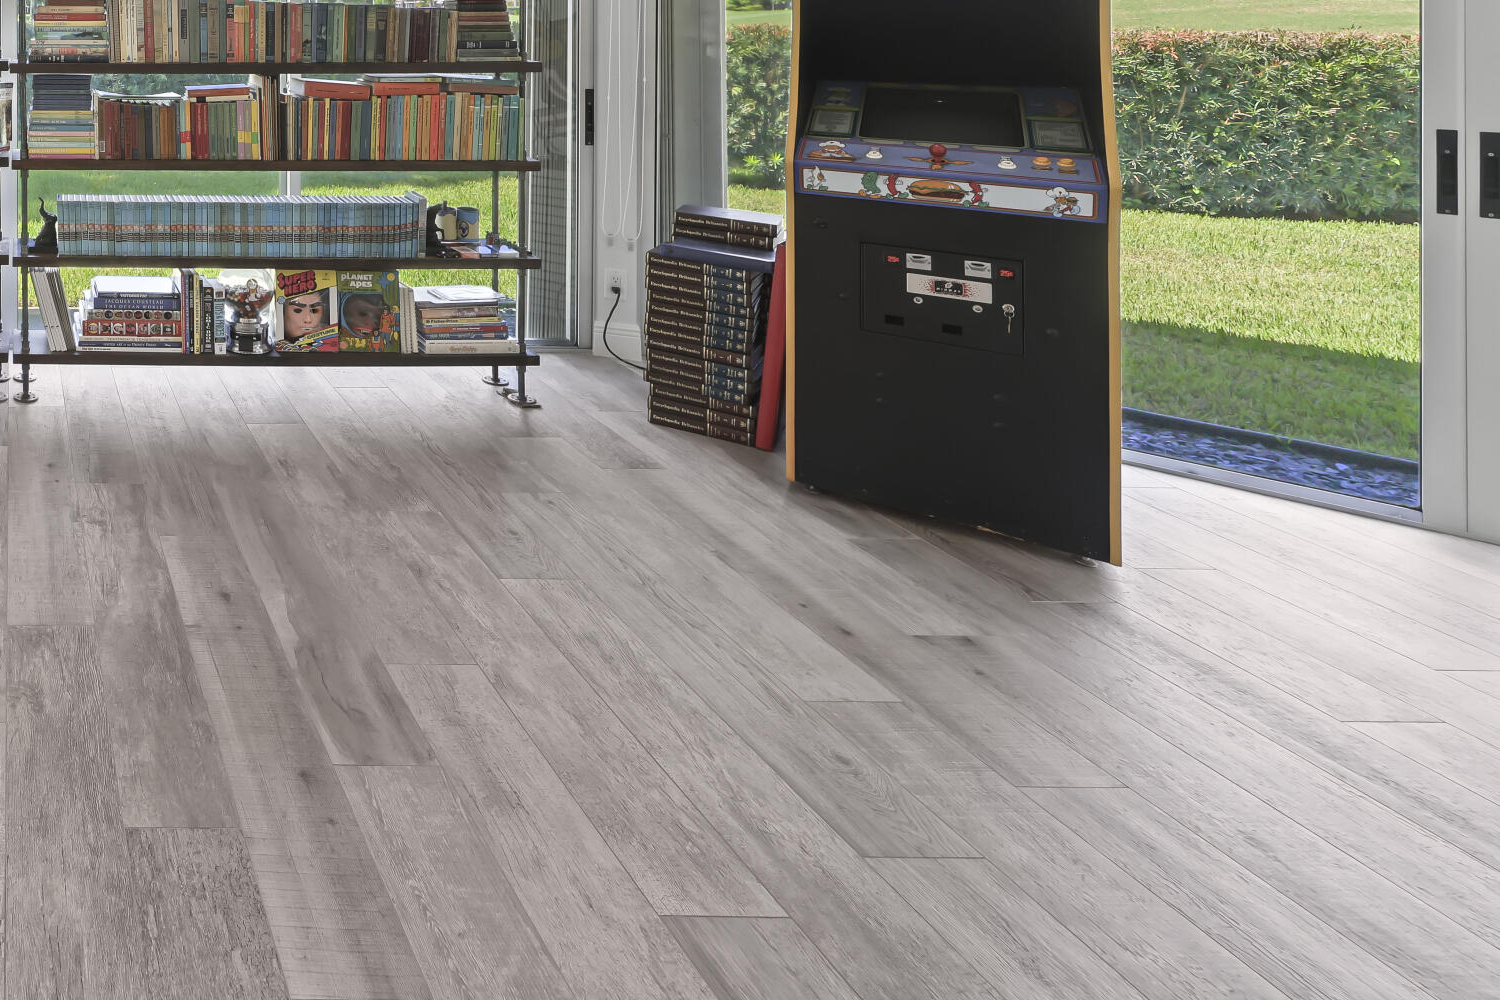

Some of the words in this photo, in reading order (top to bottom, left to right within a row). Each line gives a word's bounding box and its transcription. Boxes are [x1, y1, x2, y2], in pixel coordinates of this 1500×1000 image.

[277, 270, 316, 290] SUPER
[284, 280, 317, 297] HERO
[306, 328, 337, 340] COSTUME
